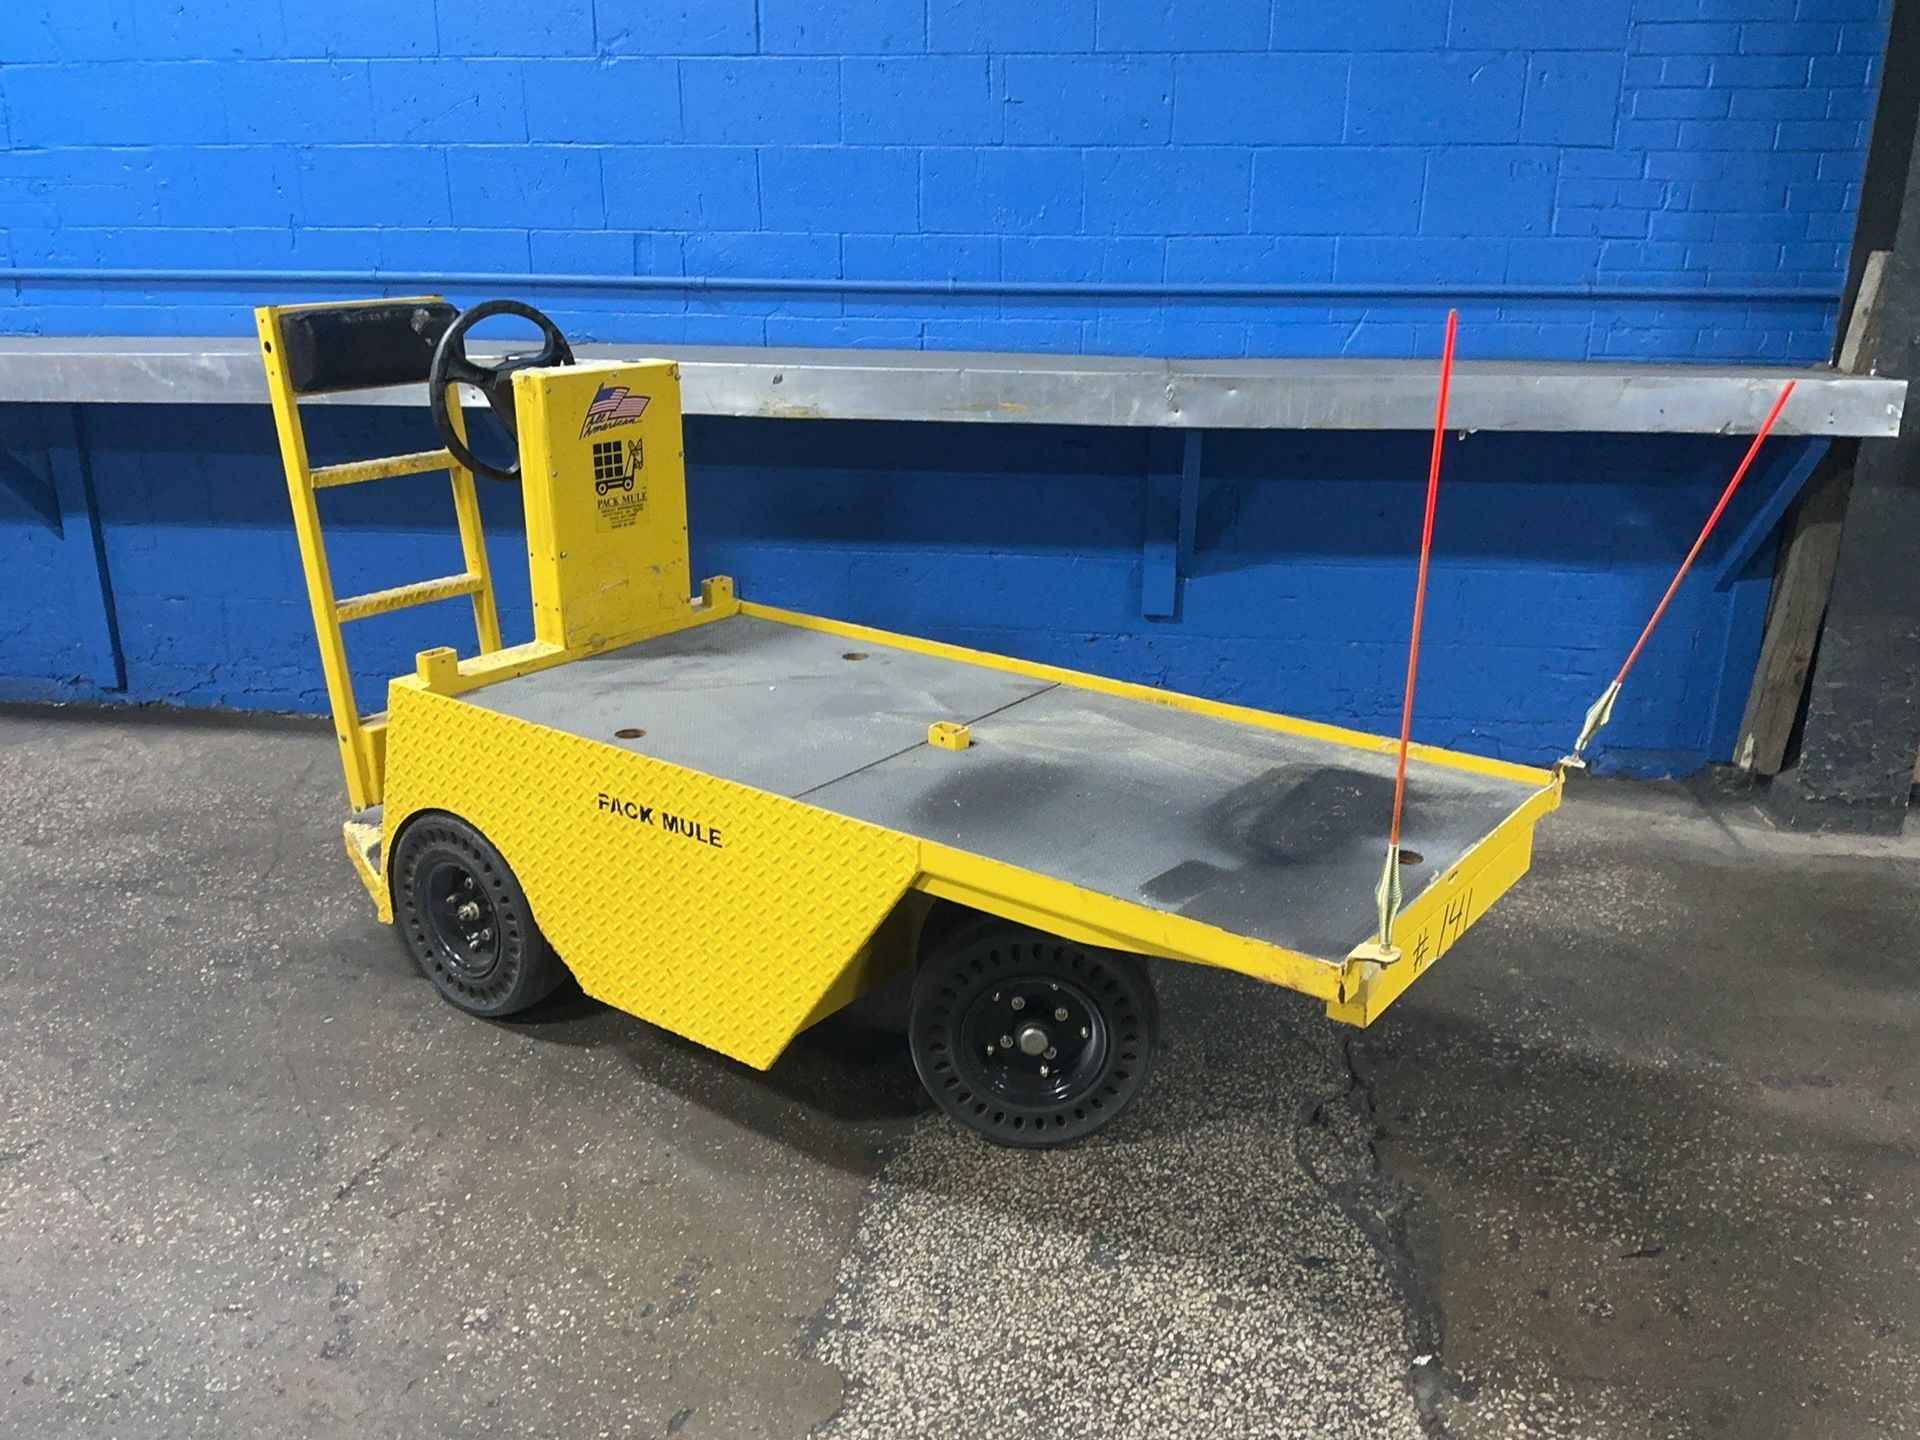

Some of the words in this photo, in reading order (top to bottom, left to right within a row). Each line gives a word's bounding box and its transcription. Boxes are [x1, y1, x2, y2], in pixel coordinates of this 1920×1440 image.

[583, 418, 641, 437] American
[597, 497, 619, 509] PACK
[621, 491, 648, 504] MULE
[598, 792, 654, 825] PACK
[661, 812, 723, 848] MULE
